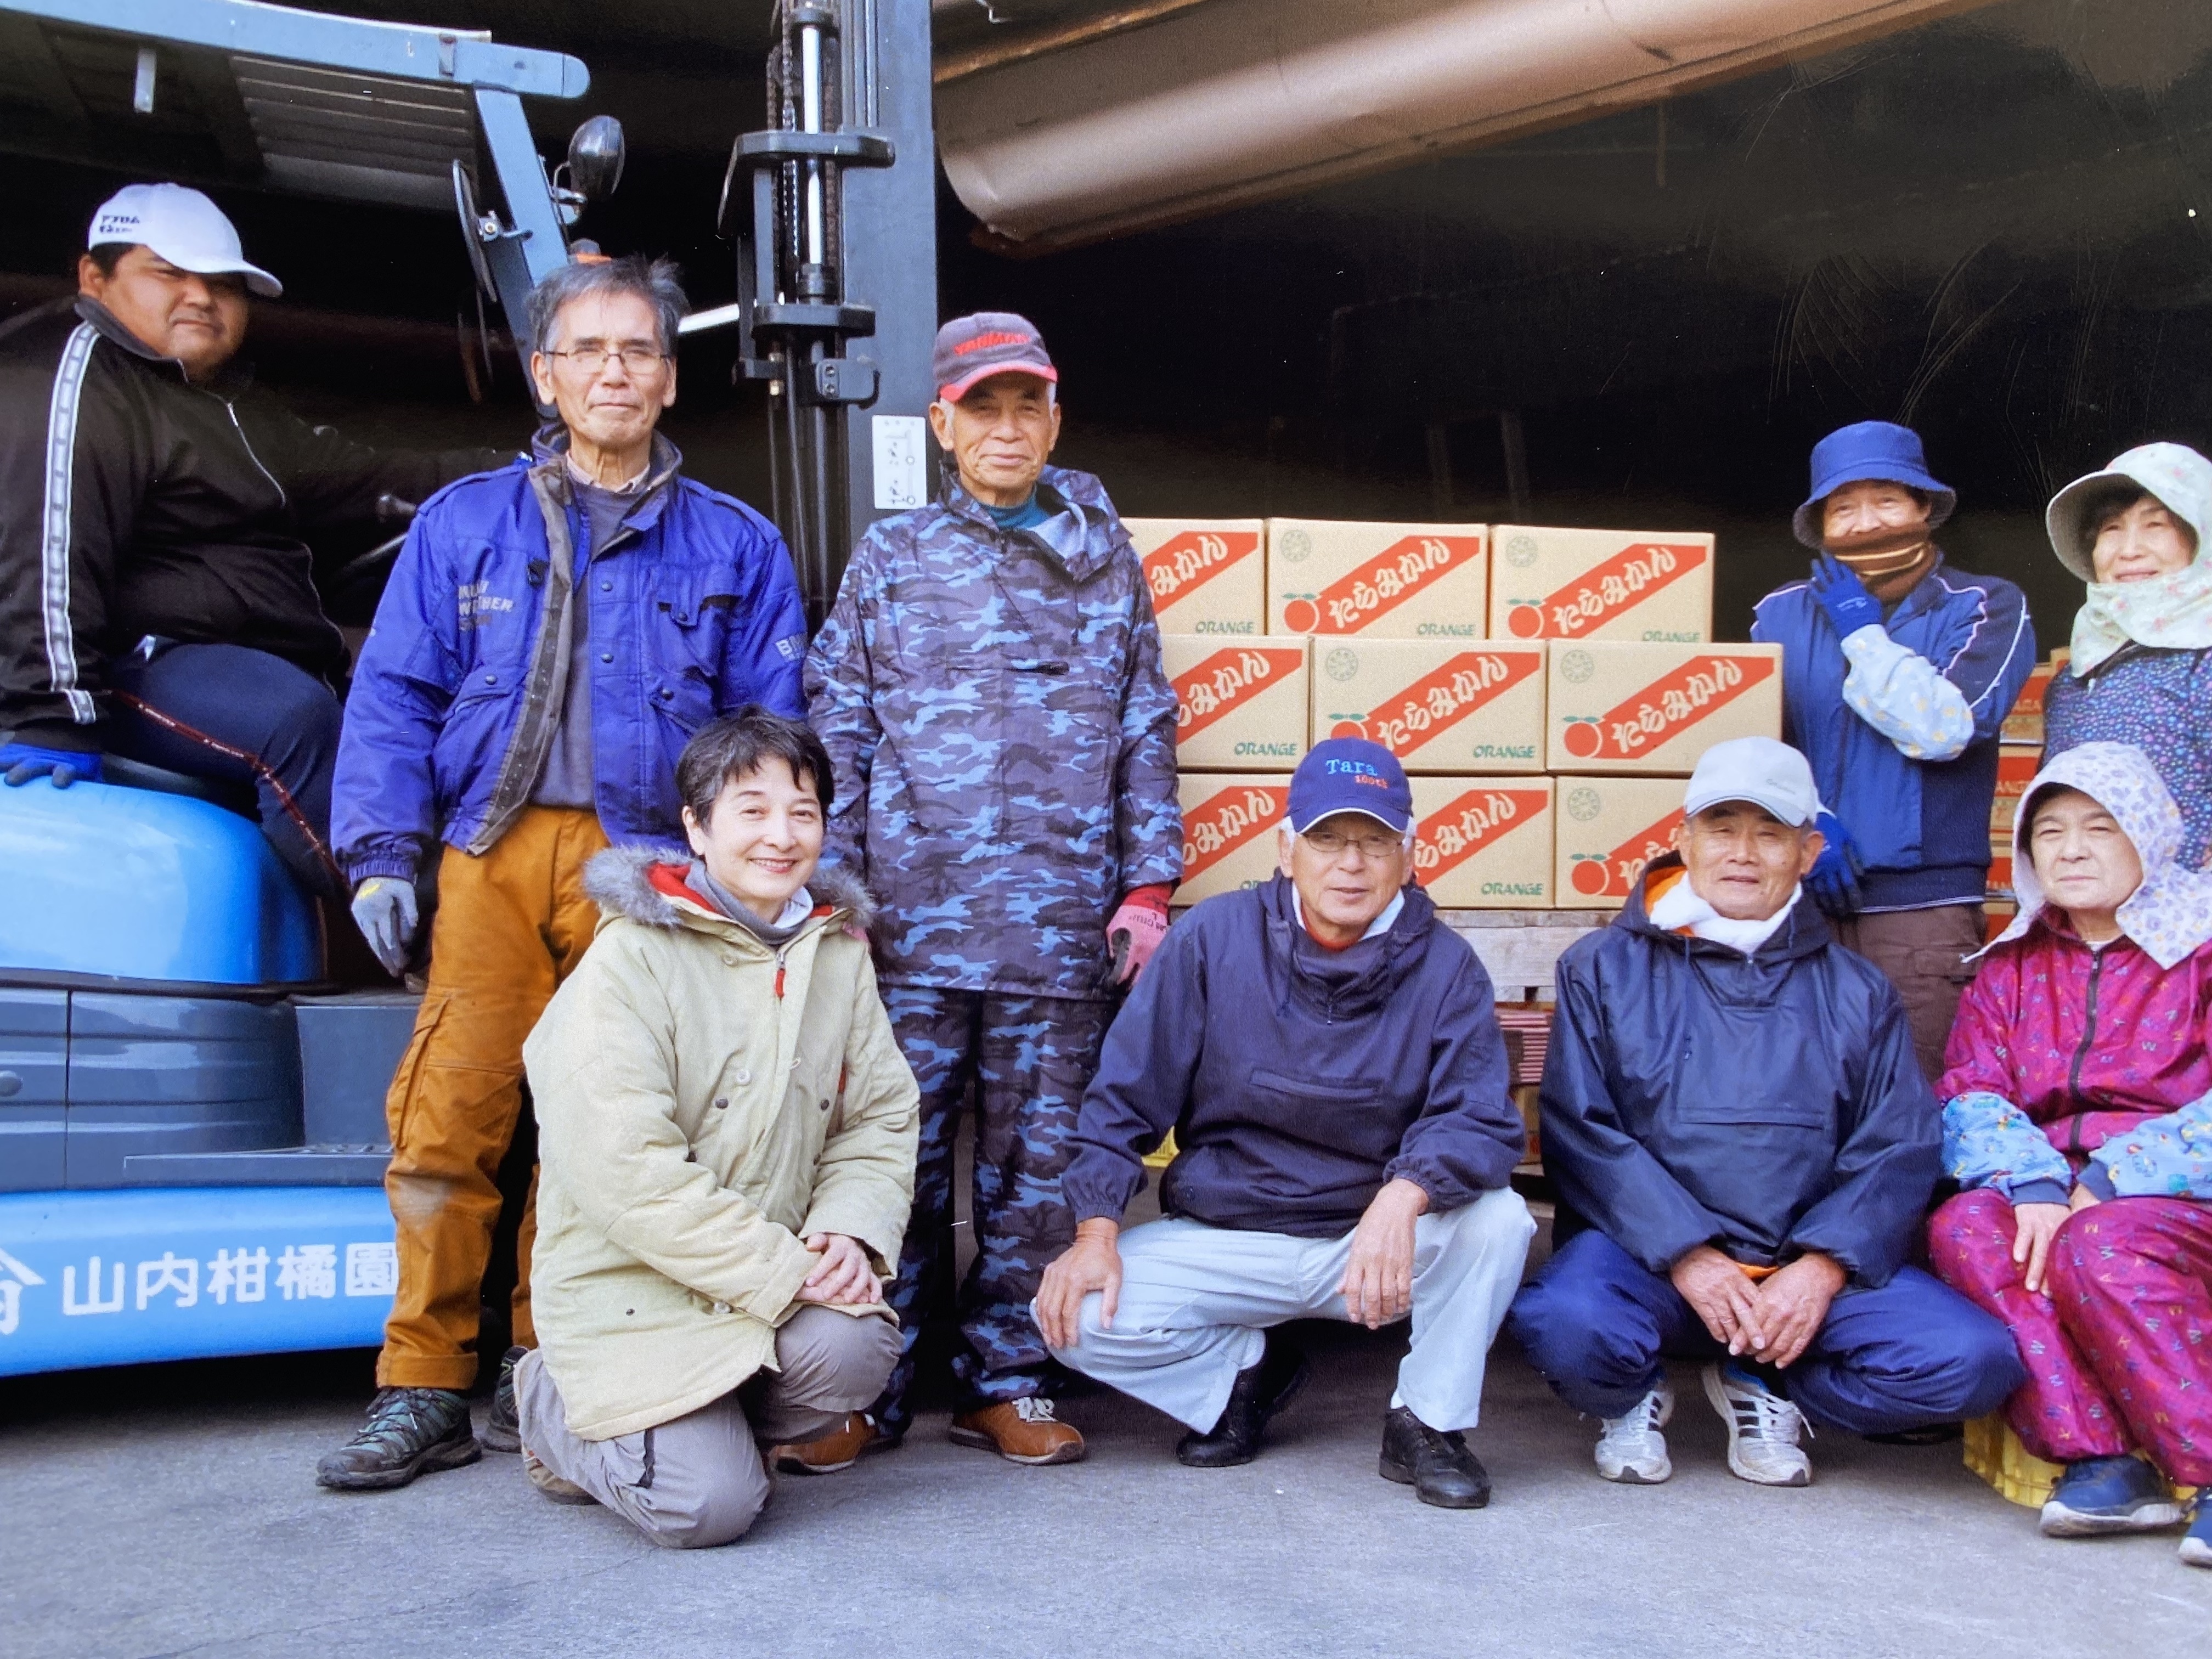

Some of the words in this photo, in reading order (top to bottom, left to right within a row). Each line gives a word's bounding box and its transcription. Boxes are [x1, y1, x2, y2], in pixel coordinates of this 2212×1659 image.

[1150, 533, 1228, 603] みかん
[1195, 620, 1254, 634] ORANGE
[1417, 623, 1475, 635] ORANGE
[1642, 630, 1700, 642] ORANGE
[1234, 742, 1297, 755] ORANGE
[1472, 744, 1536, 758] ORANGE
[1325, 758, 1378, 776] Tara
[1414, 792, 1516, 877] らみかん
[1481, 882, 1544, 896] ORANGE
[63, 1242, 399, 1316] 山内柑橘園
